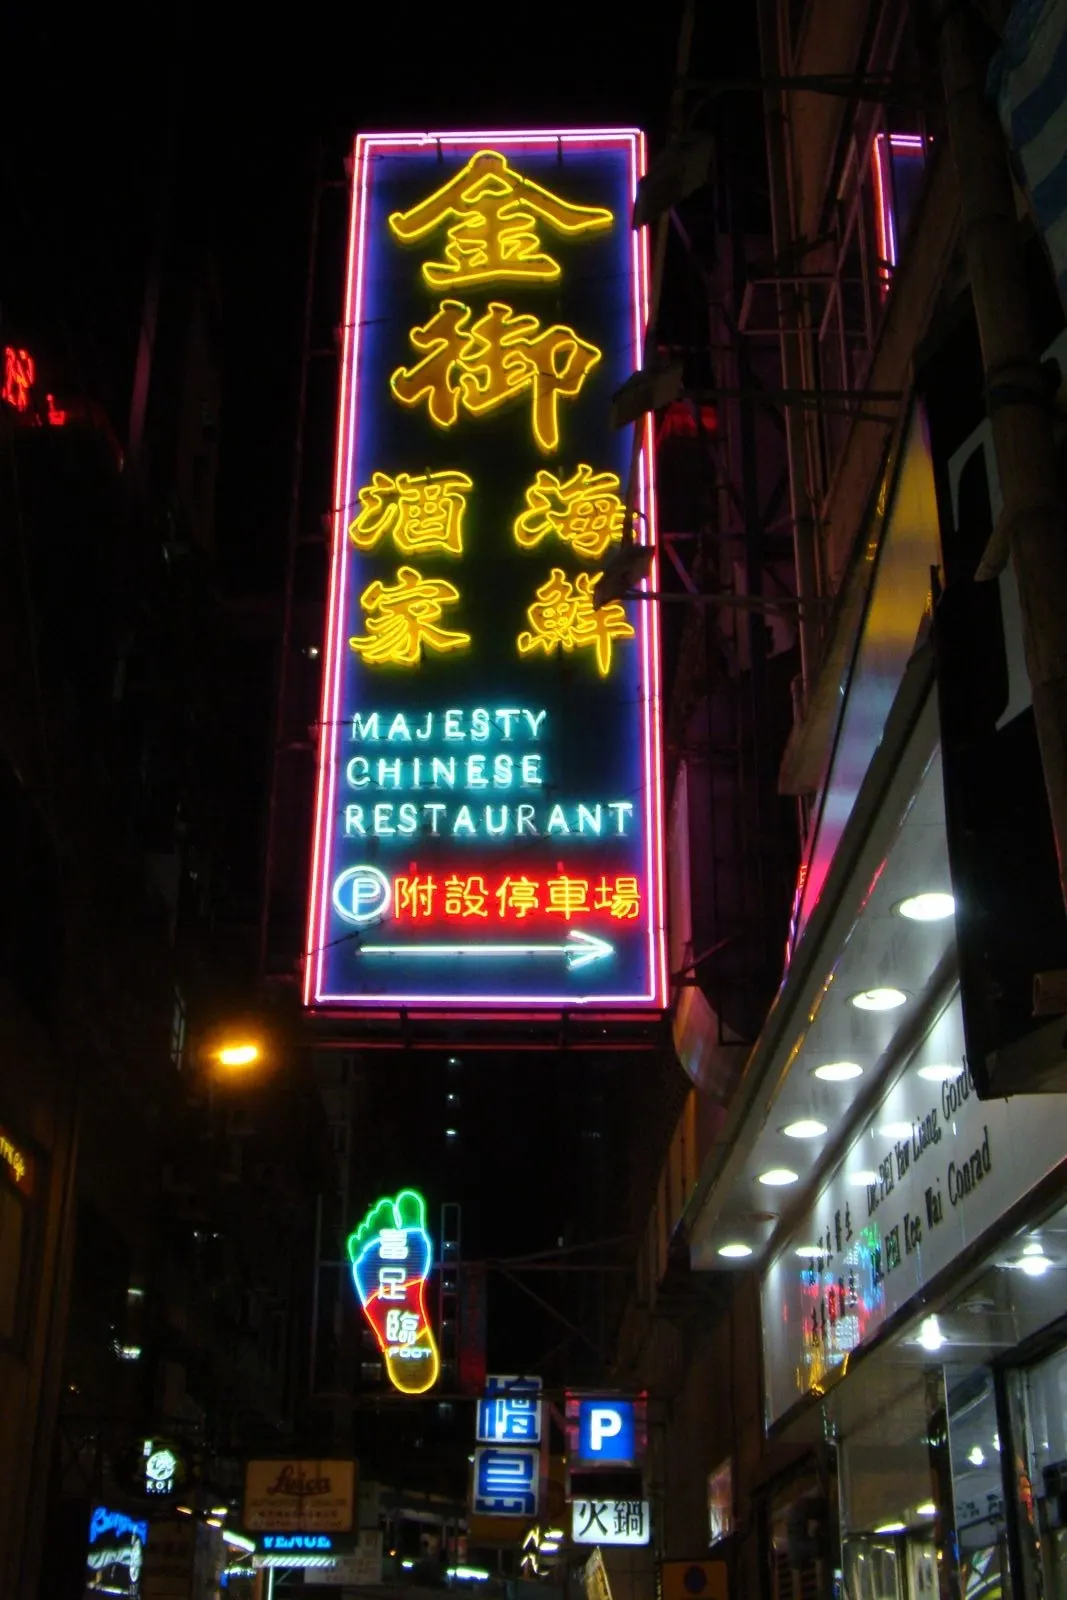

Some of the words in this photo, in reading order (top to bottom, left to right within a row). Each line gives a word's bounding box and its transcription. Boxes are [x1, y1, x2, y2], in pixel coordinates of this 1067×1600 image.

[388, 150, 613, 450] 金御
[349, 470, 473, 666] 酒家
[514, 463, 636, 676] 海鮮
[351, 708, 548, 742] MAJESTY
[346, 754, 545, 788] CHINESE
[344, 802, 635, 836] RESTAURANT
[394, 875, 641, 920] 附設停車場
[903, 1213, 922, 1256] Kee
[924, 1176, 944, 1230] Wai
[947, 1124, 993, 1207] Conrad
[589, 1408, 623, 1451] P
[267, 1464, 331, 1496] Leica
[578, 1500, 645, 1539] 火鍋
